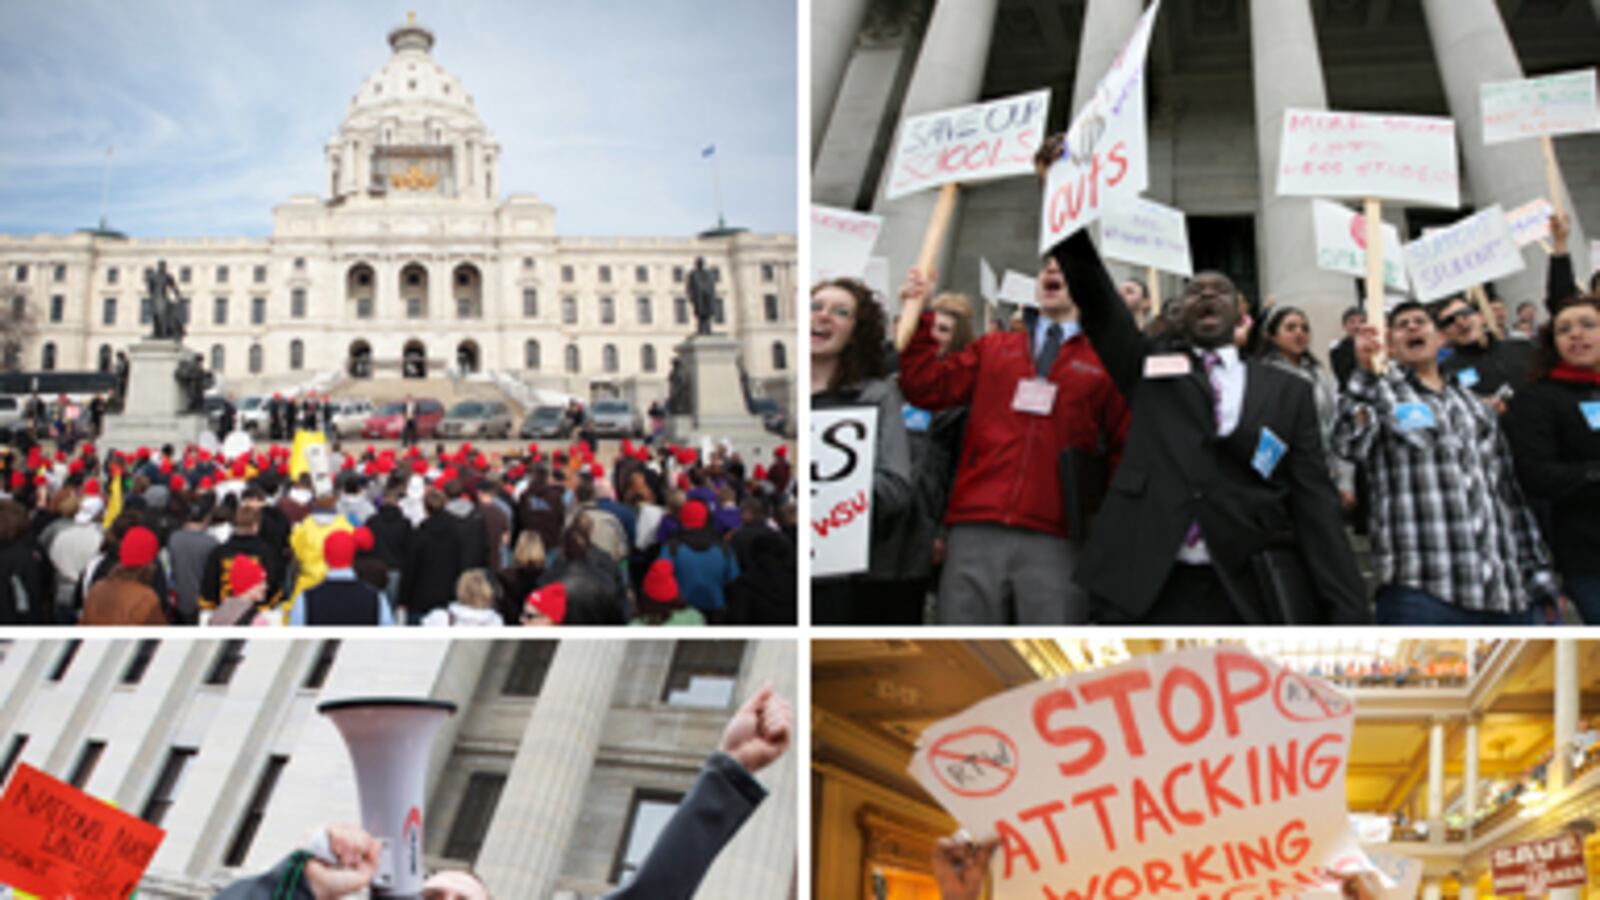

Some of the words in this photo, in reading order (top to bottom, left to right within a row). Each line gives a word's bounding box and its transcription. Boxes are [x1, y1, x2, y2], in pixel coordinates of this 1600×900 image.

[1032, 652, 1271, 777] STOP
[994, 733, 1345, 880] ATTACKING
[1042, 820, 1312, 900] WORKING
